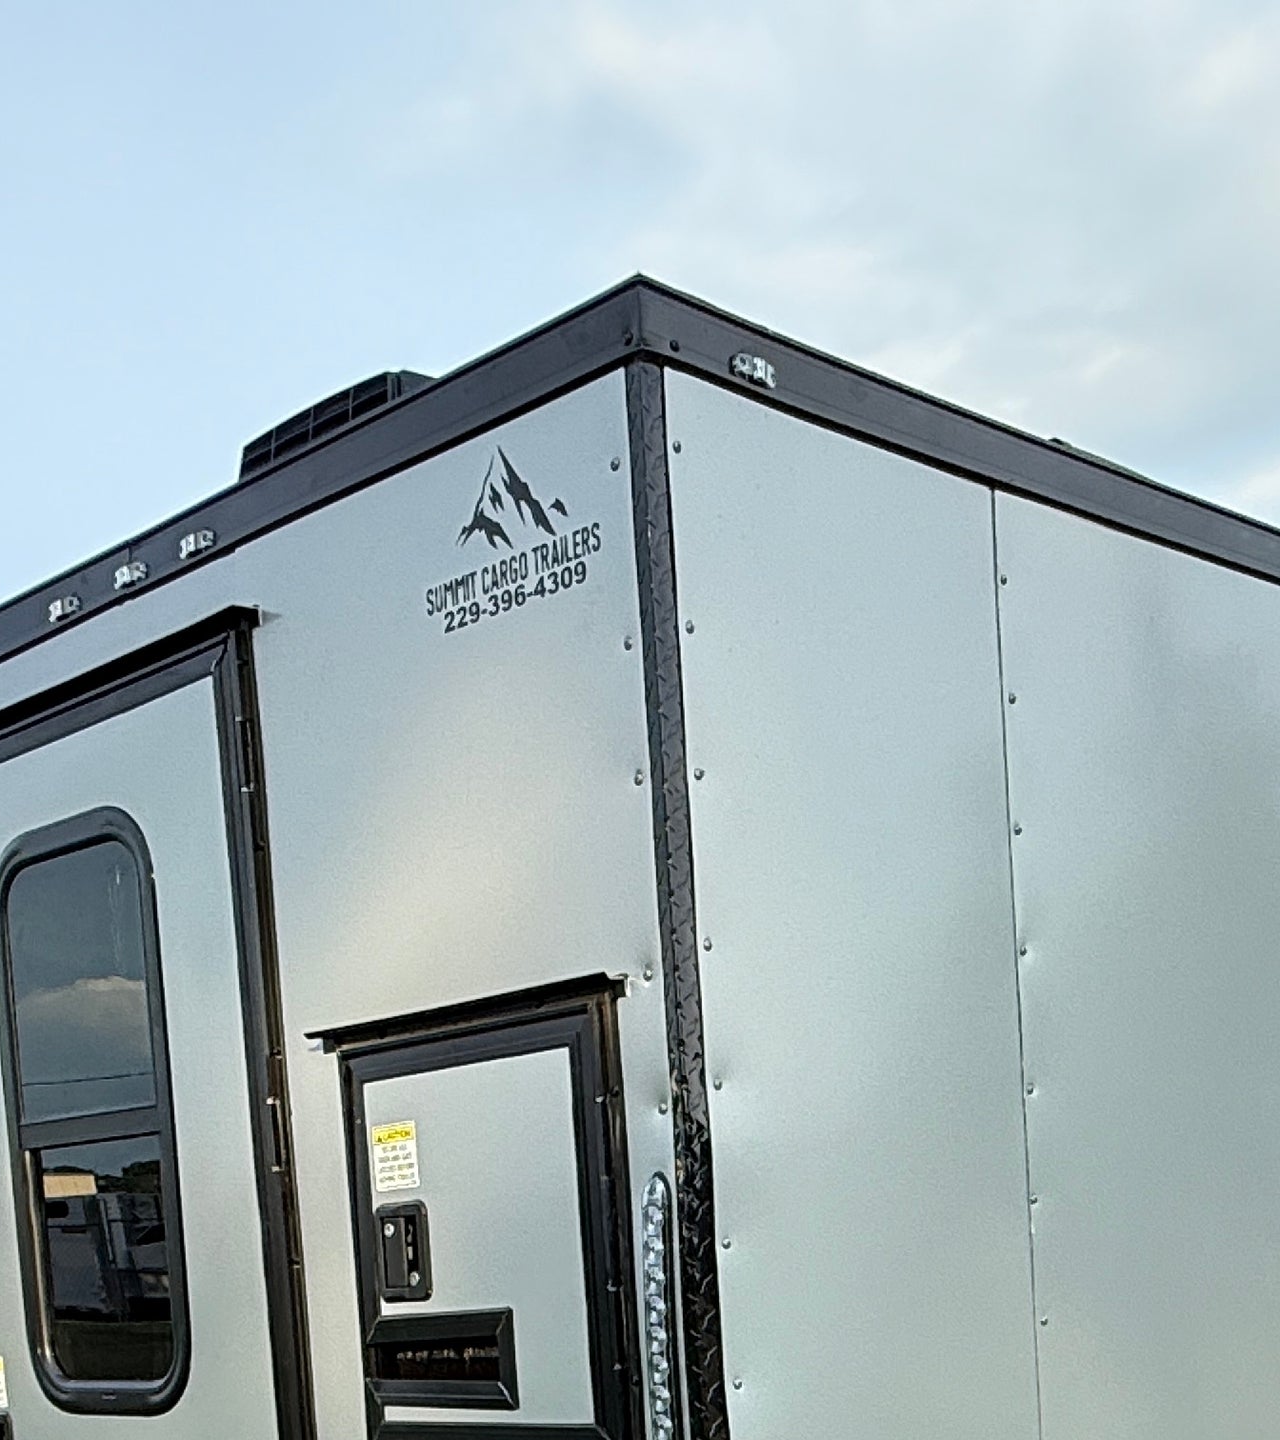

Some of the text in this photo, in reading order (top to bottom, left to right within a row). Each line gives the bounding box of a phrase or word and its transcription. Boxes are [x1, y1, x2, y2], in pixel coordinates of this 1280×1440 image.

[426, 522, 601, 616] SUMMIT CARGO TRAILERS
[444, 560, 587, 633] 229-396-4309
